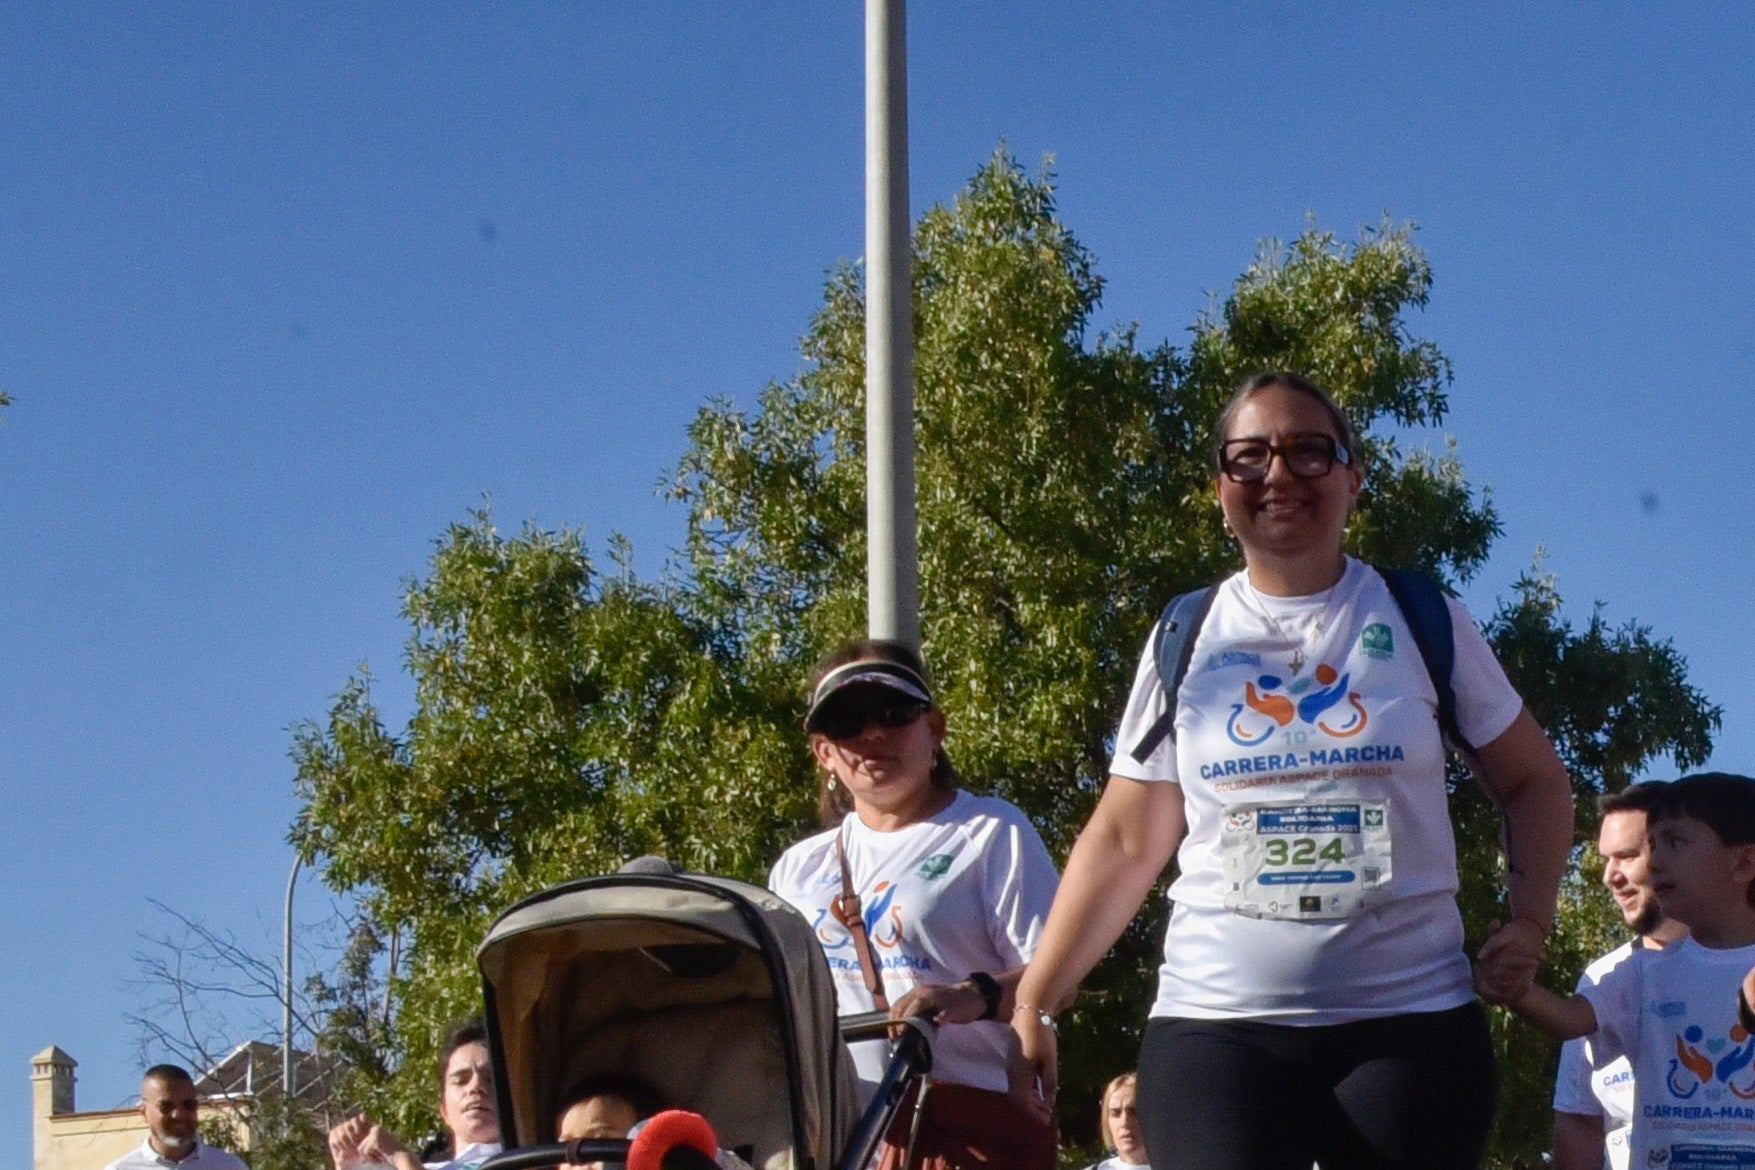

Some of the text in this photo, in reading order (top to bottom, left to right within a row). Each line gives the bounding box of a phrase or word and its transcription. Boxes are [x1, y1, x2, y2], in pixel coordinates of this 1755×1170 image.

[1200, 745, 1404, 780] CARRERA-MARCHA
[1214, 775, 1277, 793] SOLIDARIA
[1332, 766, 1392, 780] GRANADA
[1265, 837, 1345, 866] 324
